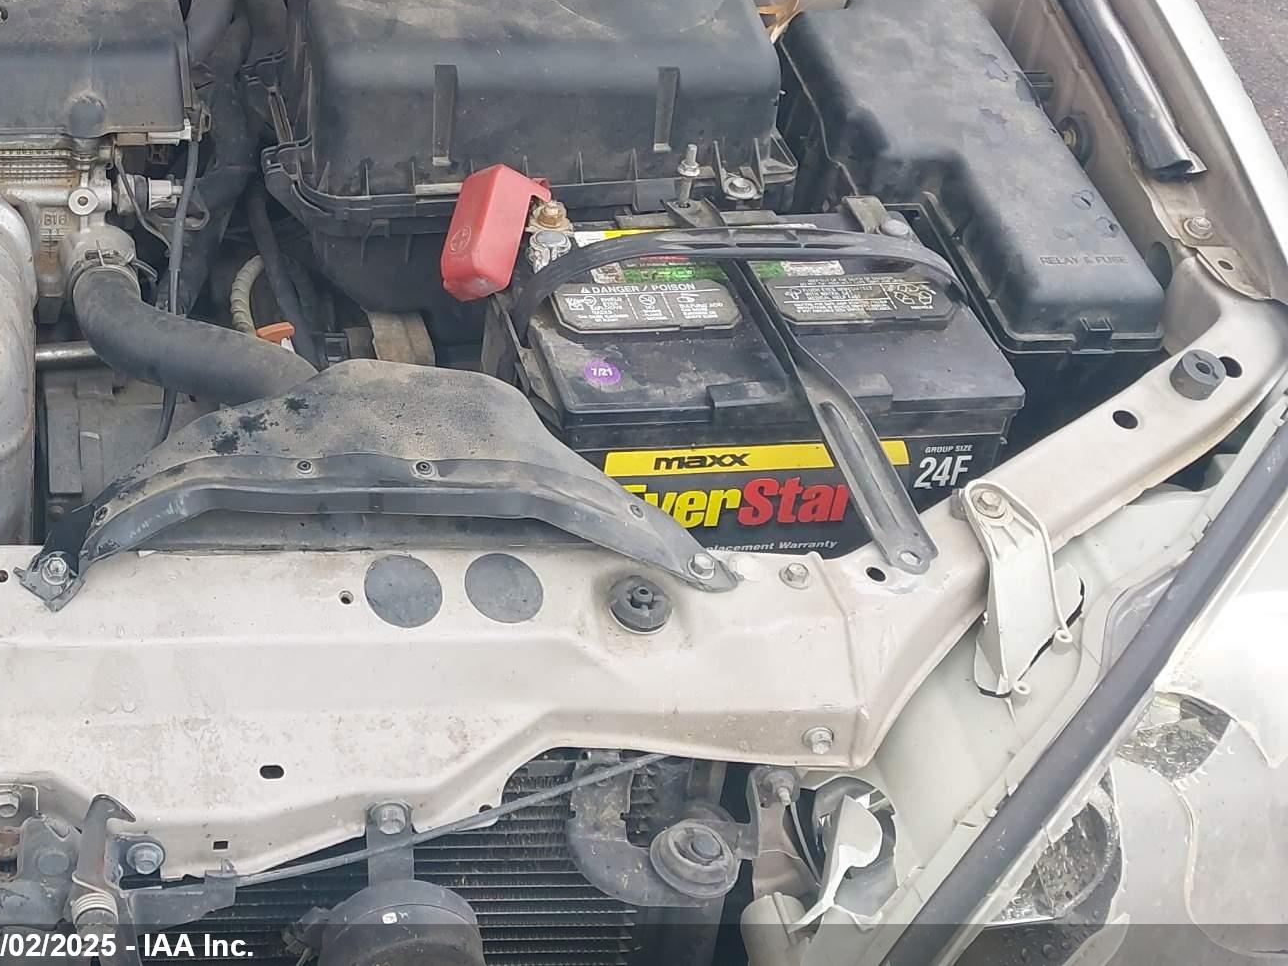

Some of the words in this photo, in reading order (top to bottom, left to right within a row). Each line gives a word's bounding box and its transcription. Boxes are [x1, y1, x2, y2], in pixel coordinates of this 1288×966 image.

[1039, 256, 1080, 265] RELAY
[1095, 255, 1129, 264] FUSE
[592, 285, 639, 294] DANGER
[651, 283, 696, 291] POISON
[925, 445, 954, 454] GROUP
[954, 444, 973, 452] SIZE
[653, 452, 752, 471] maxx
[913, 455, 973, 489] 24F
[778, 540, 838, 550] Warranty
